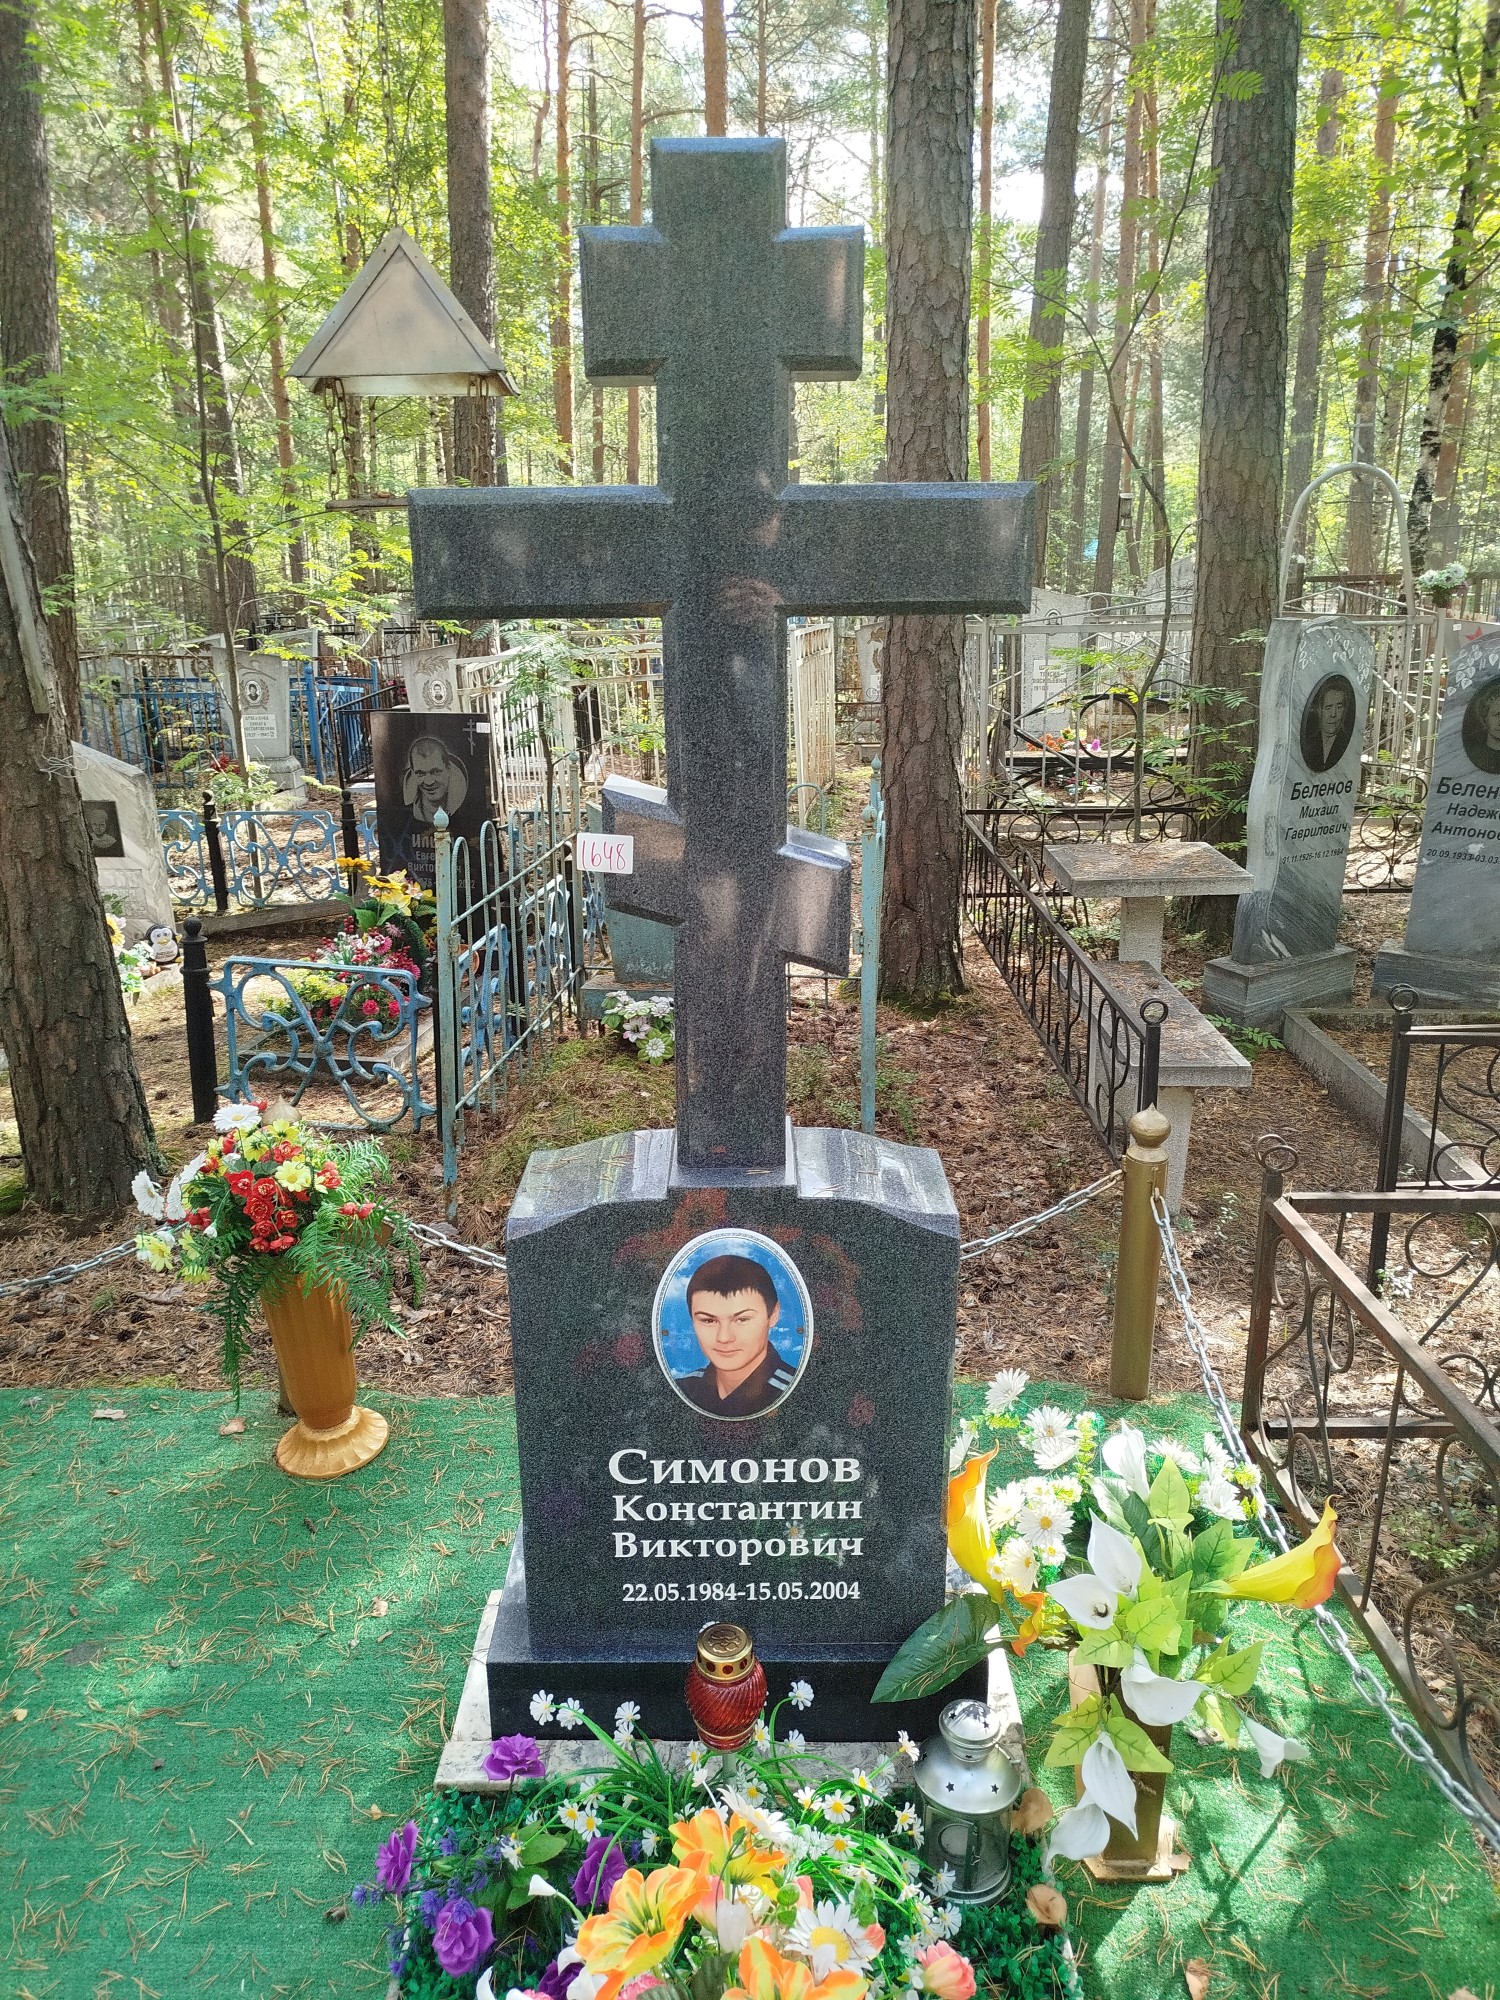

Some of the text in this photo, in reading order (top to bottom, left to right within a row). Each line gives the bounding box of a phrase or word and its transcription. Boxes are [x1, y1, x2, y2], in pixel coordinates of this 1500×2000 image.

[1290, 780, 1353, 800] Беленов
[1436, 776, 1500, 800] Белен
[1299, 805, 1339, 819] Михаил
[1446, 802, 1500, 821] Надеж
[1285, 823, 1348, 841] Гаврилович
[581, 840, 626, 870] 1648
[608, 1448, 861, 1484] Симонов
[612, 1495, 863, 1521] Константин
[612, 1532, 864, 1566] Викторович
[622, 1582, 860, 1602] 22.05.1984-15.05.2004
